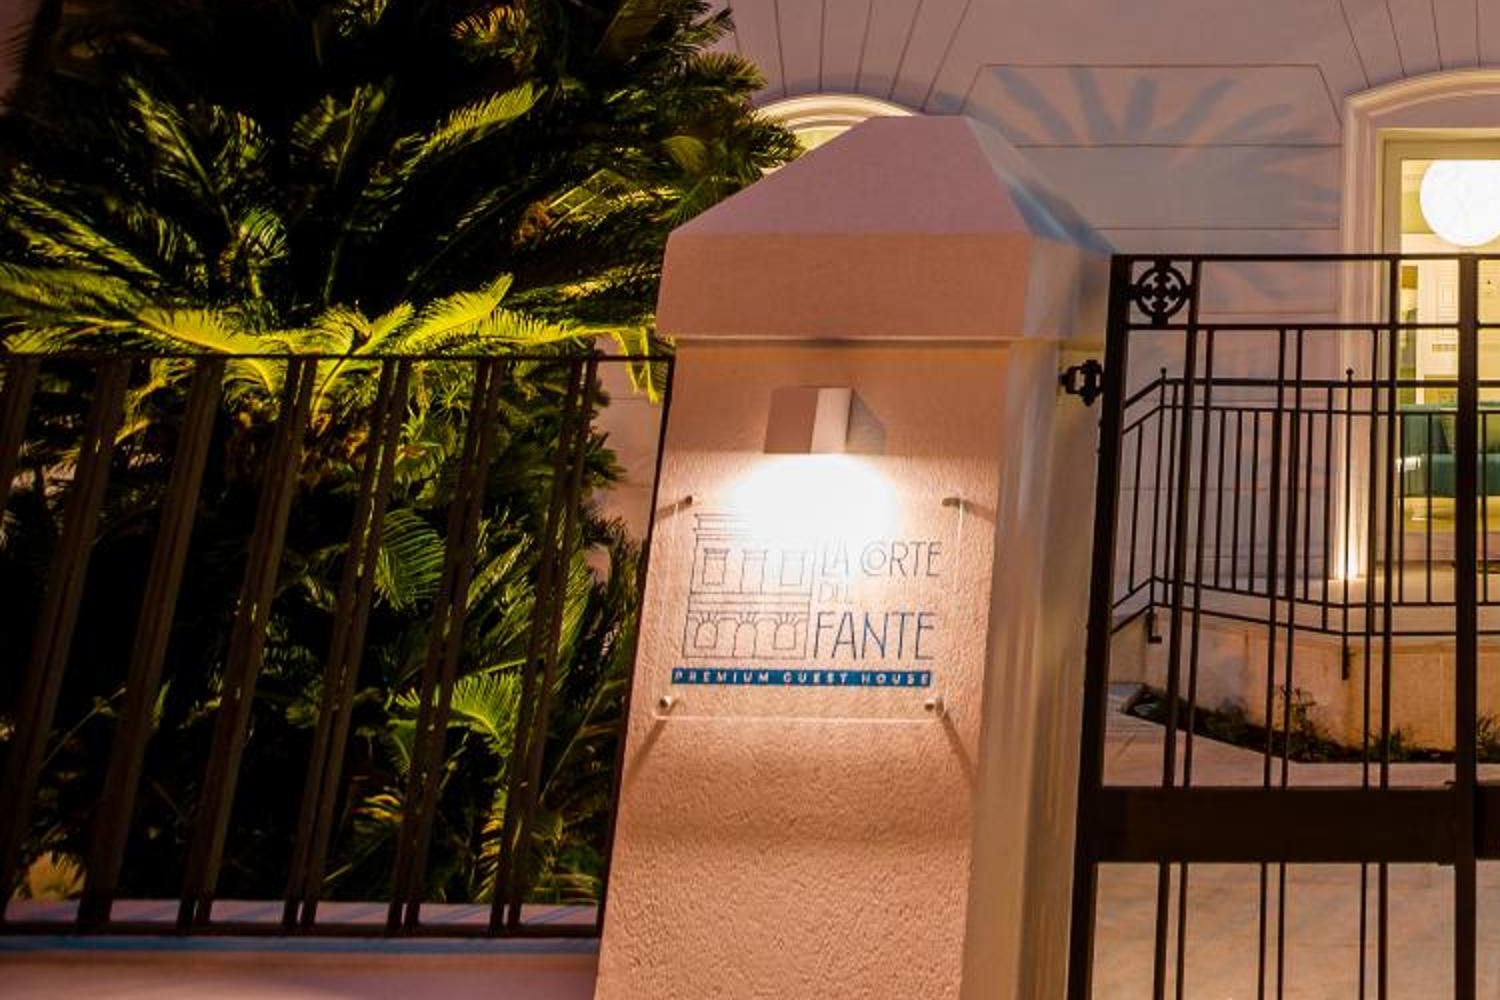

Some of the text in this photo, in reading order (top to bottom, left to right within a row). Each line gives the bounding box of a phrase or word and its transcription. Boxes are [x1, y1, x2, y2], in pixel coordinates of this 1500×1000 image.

[821, 540, 943, 577] LA CORTE
[812, 610, 938, 661] FANTE
[674, 670, 929, 685] PREMIUM GUEST HOUSE
